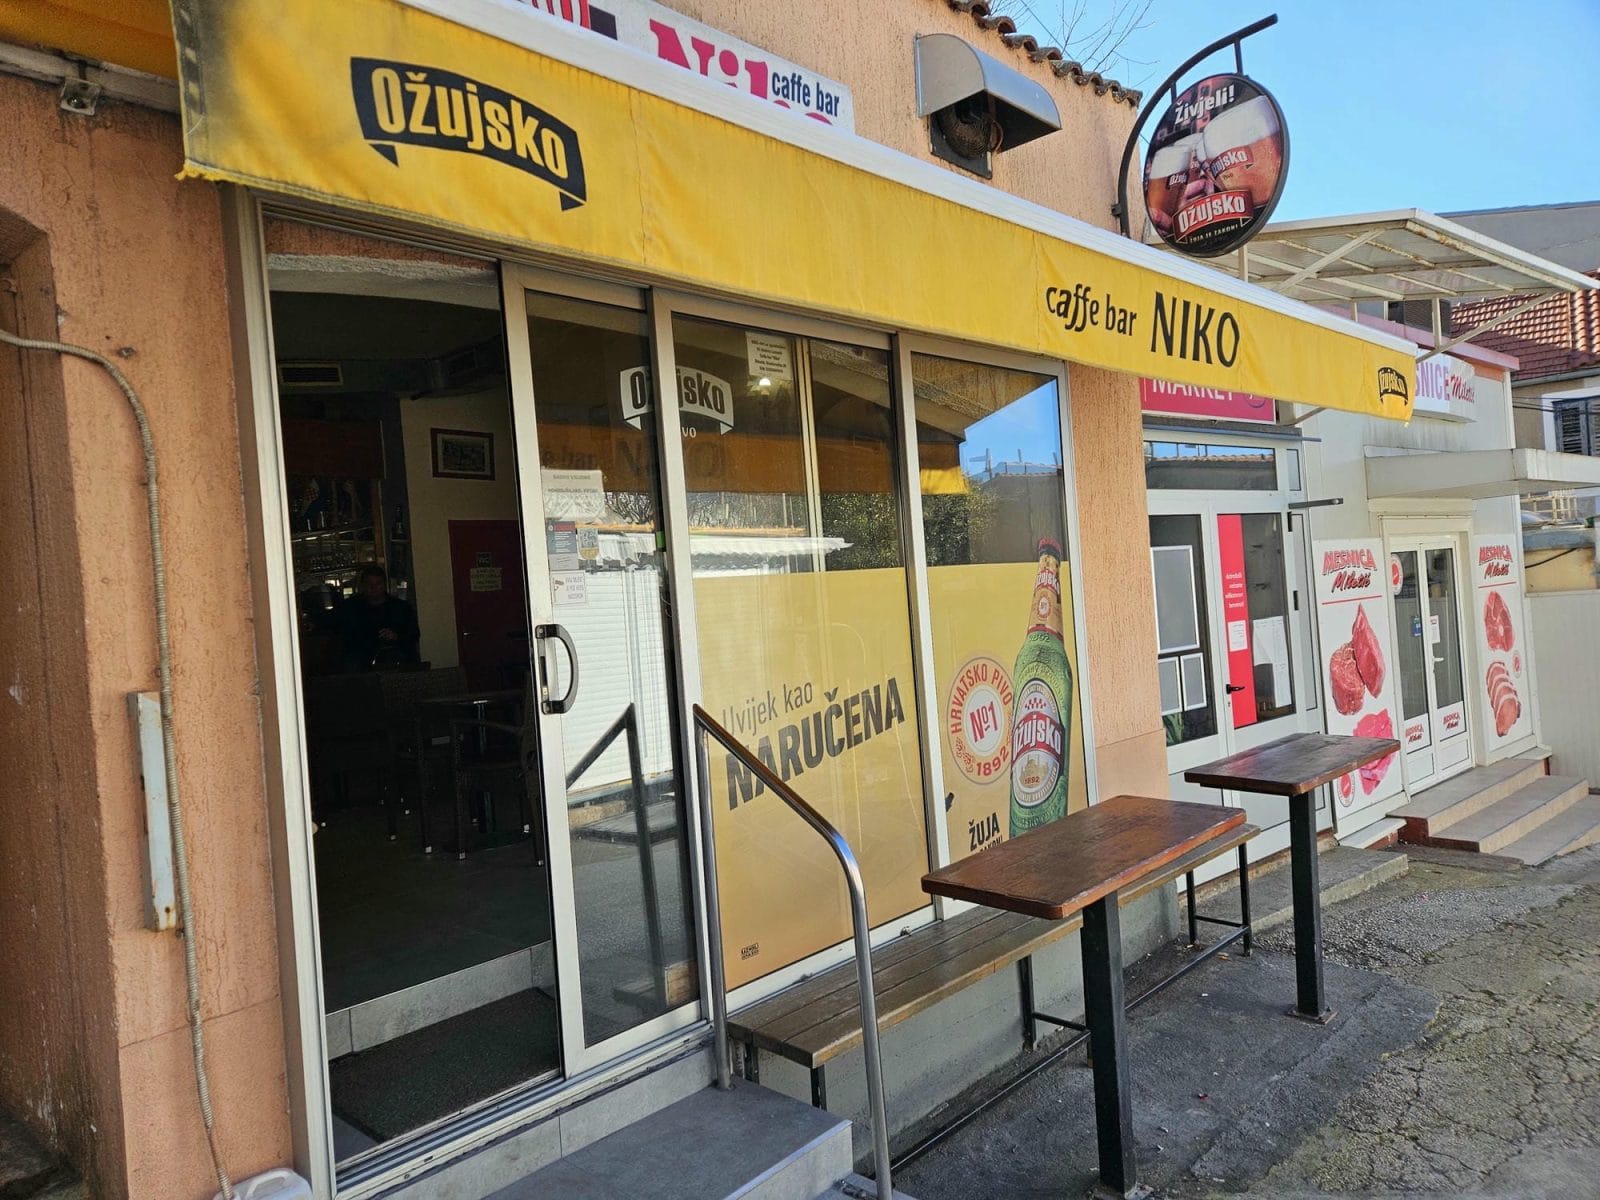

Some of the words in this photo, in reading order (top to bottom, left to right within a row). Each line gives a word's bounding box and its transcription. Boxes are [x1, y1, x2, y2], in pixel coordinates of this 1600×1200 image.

[771, 71, 811, 108] caffe
[816, 81, 841, 117] bar
[1174, 84, 1235, 125] Živjeli!
[371, 66, 569, 180] Ožujsko
[1178, 195, 1246, 233] Ožujsko
[1046, 283, 1100, 332] caffe
[1105, 293, 1138, 337] bar
[1150, 290, 1241, 368] NIKO
[1322, 548, 1378, 576] MESNICA
[722, 690, 778, 736] Uvijek
[783, 681, 814, 714] kao
[950, 662, 989, 735] HRVATSKO
[991, 668, 1014, 706] PIVO
[725, 677, 906, 811] NARUČENA
[976, 746, 1010, 777] 1892
[968, 812, 1001, 852] ŽUJA
